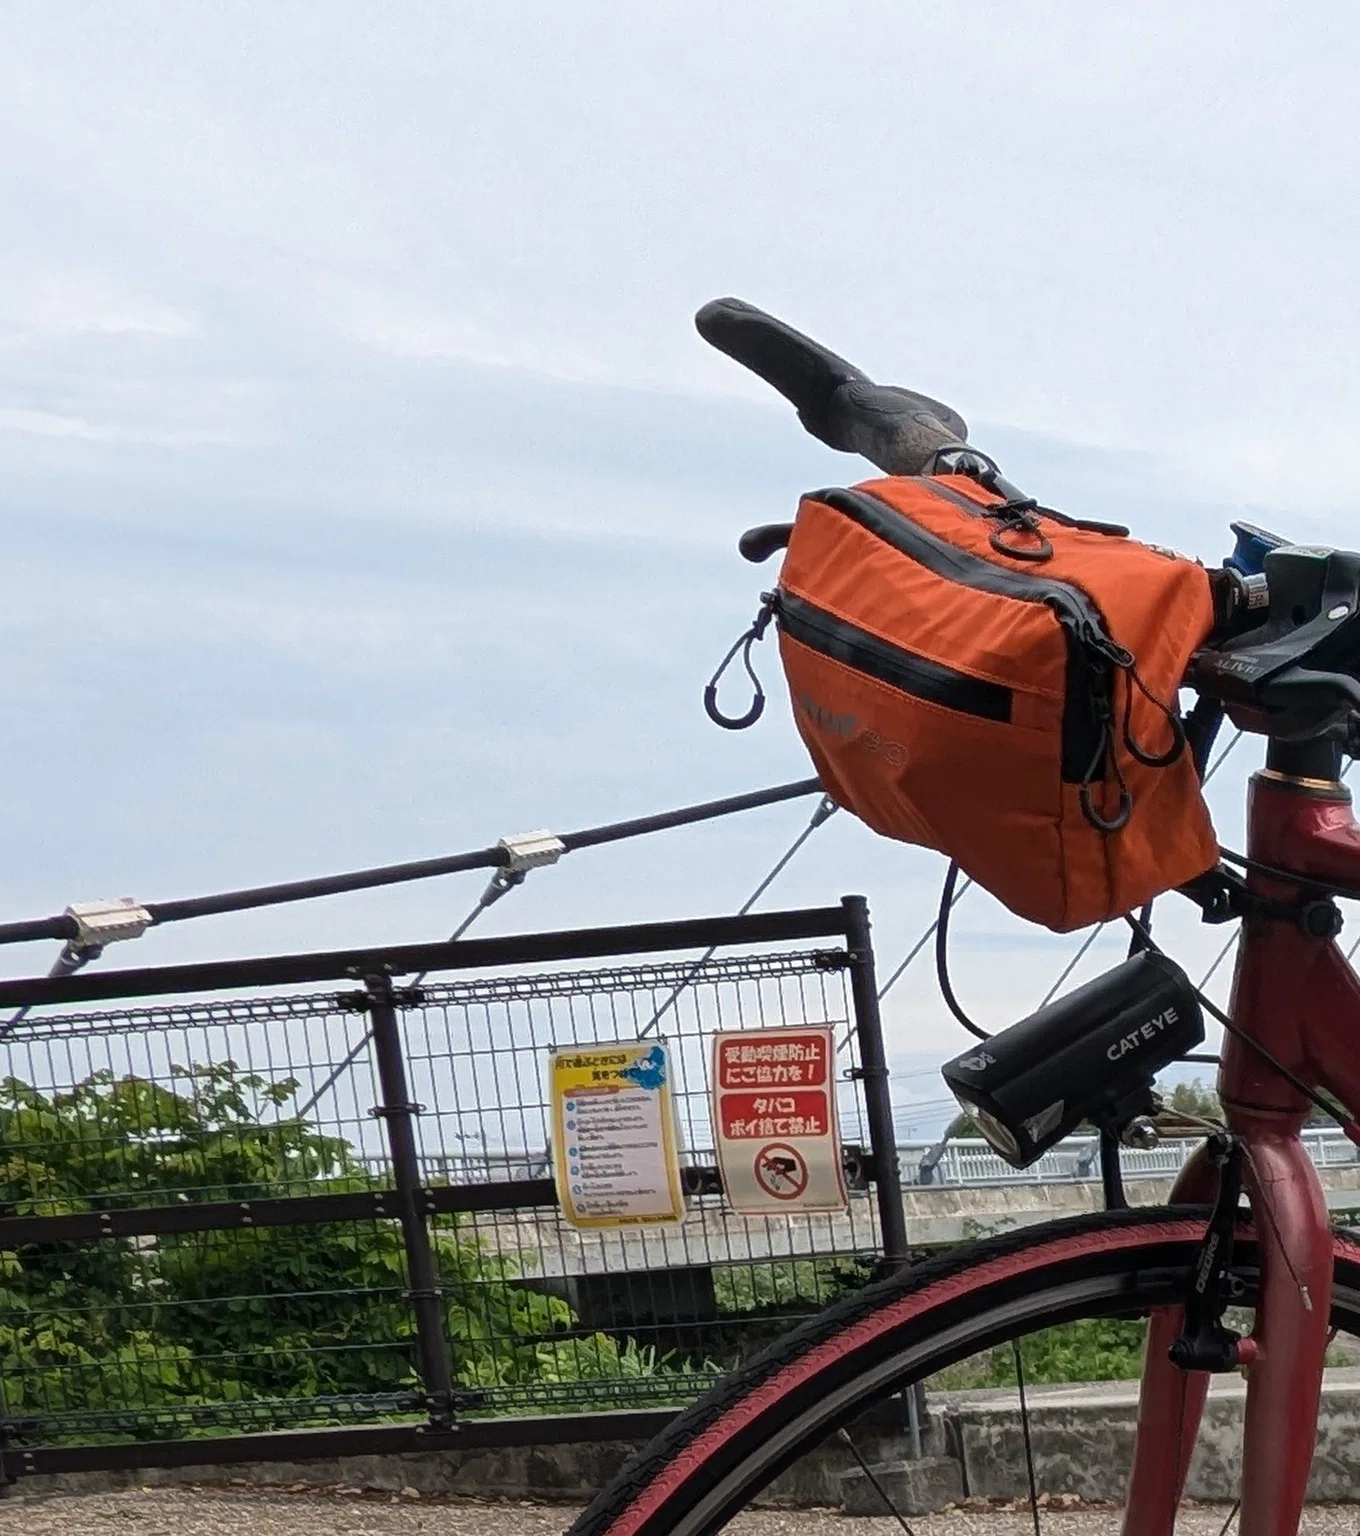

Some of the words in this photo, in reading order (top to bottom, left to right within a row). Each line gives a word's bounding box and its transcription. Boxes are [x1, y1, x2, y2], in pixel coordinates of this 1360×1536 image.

[1106, 1006, 1179, 1062] CATEYE
[725, 1043, 820, 1064] 受動喫煙防止
[752, 1097, 795, 1114] タバコ
[730, 1116, 821, 1136] ポイ捨て禁止
[1195, 1232, 1220, 1293] DEORE
